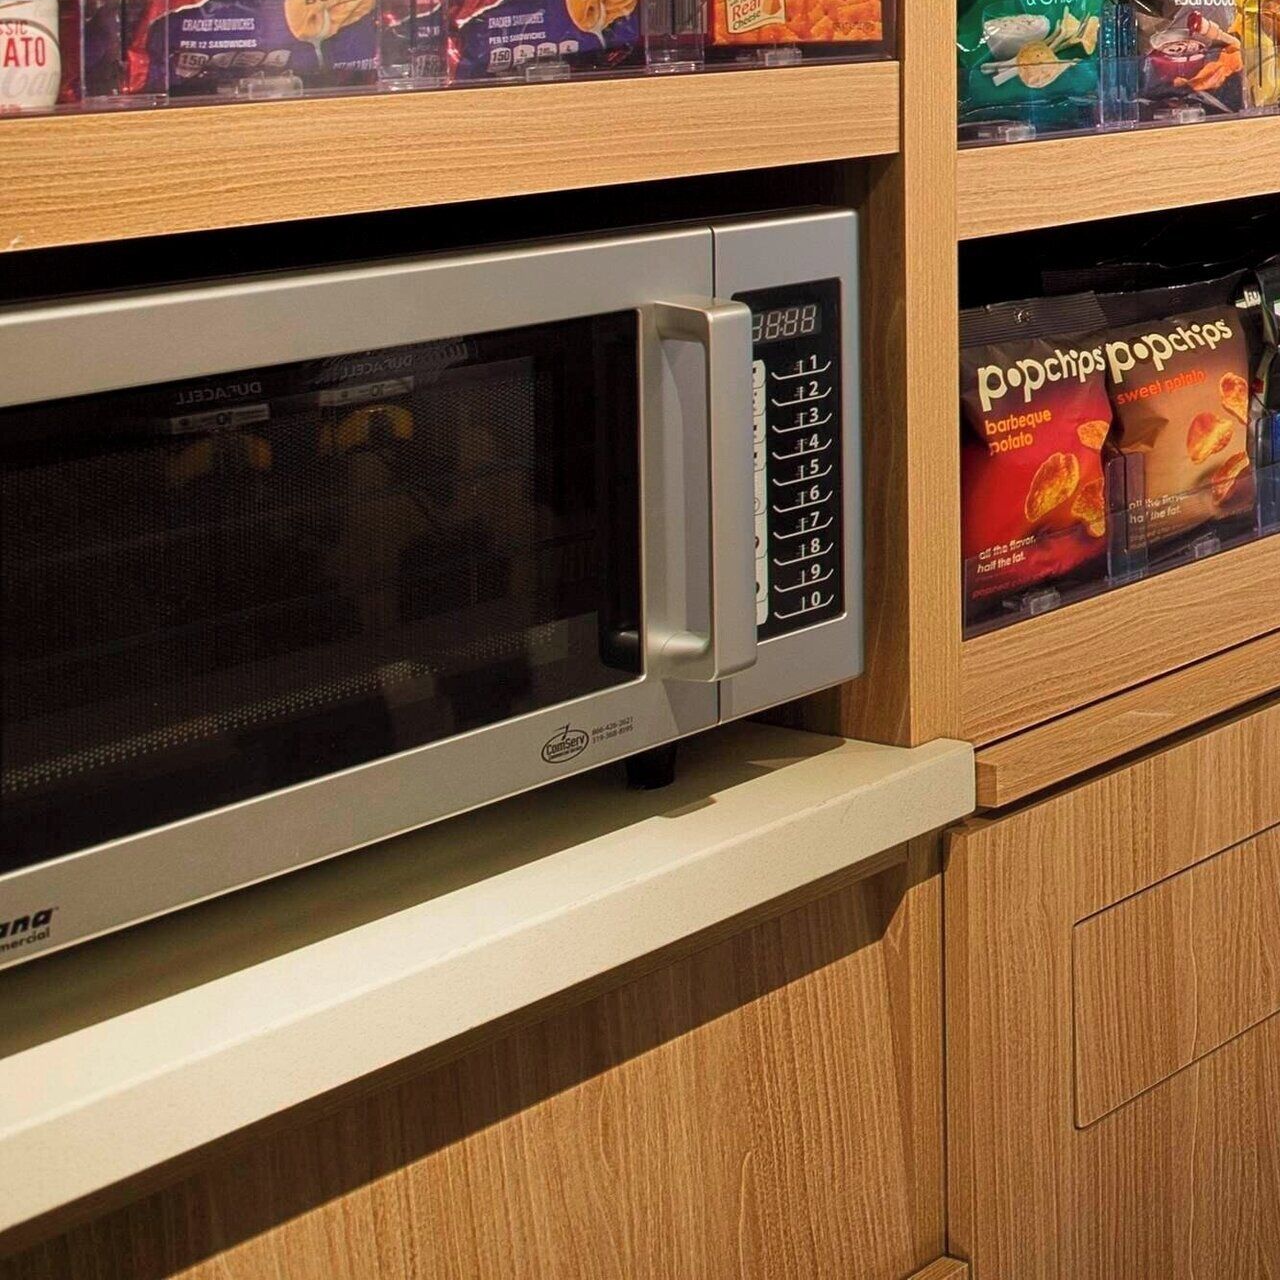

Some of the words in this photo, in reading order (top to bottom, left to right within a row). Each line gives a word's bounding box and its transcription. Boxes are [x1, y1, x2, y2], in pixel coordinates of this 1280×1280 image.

[732, 10, 762, 31] Cheese
[180, 40, 196, 49] PER
[208, 39, 257, 49] SANDWICHES
[491, 49, 511, 64] 150
[1105, 318, 1233, 385] popchips
[809, 354, 818, 370] 1
[977, 344, 1106, 413] popchips
[808, 380, 819, 397] 2
[1116, 380, 1162, 406] sweet
[1164, 369, 1206, 394] potato
[808, 407, 819, 423] 3
[984, 409, 1052, 435] barbeque
[808, 433, 819, 449] 4
[988, 431, 1034, 457] potato
[809, 458, 819, 475] 5
[809, 484, 820, 501] 6
[810, 511, 820, 528] 7
[810, 537, 821, 554] 8
[995, 555, 1012, 570] the
[810, 564, 821, 580] 9
[810, 591, 821, 607] 0
[545, 734, 585, 756] ComServ
